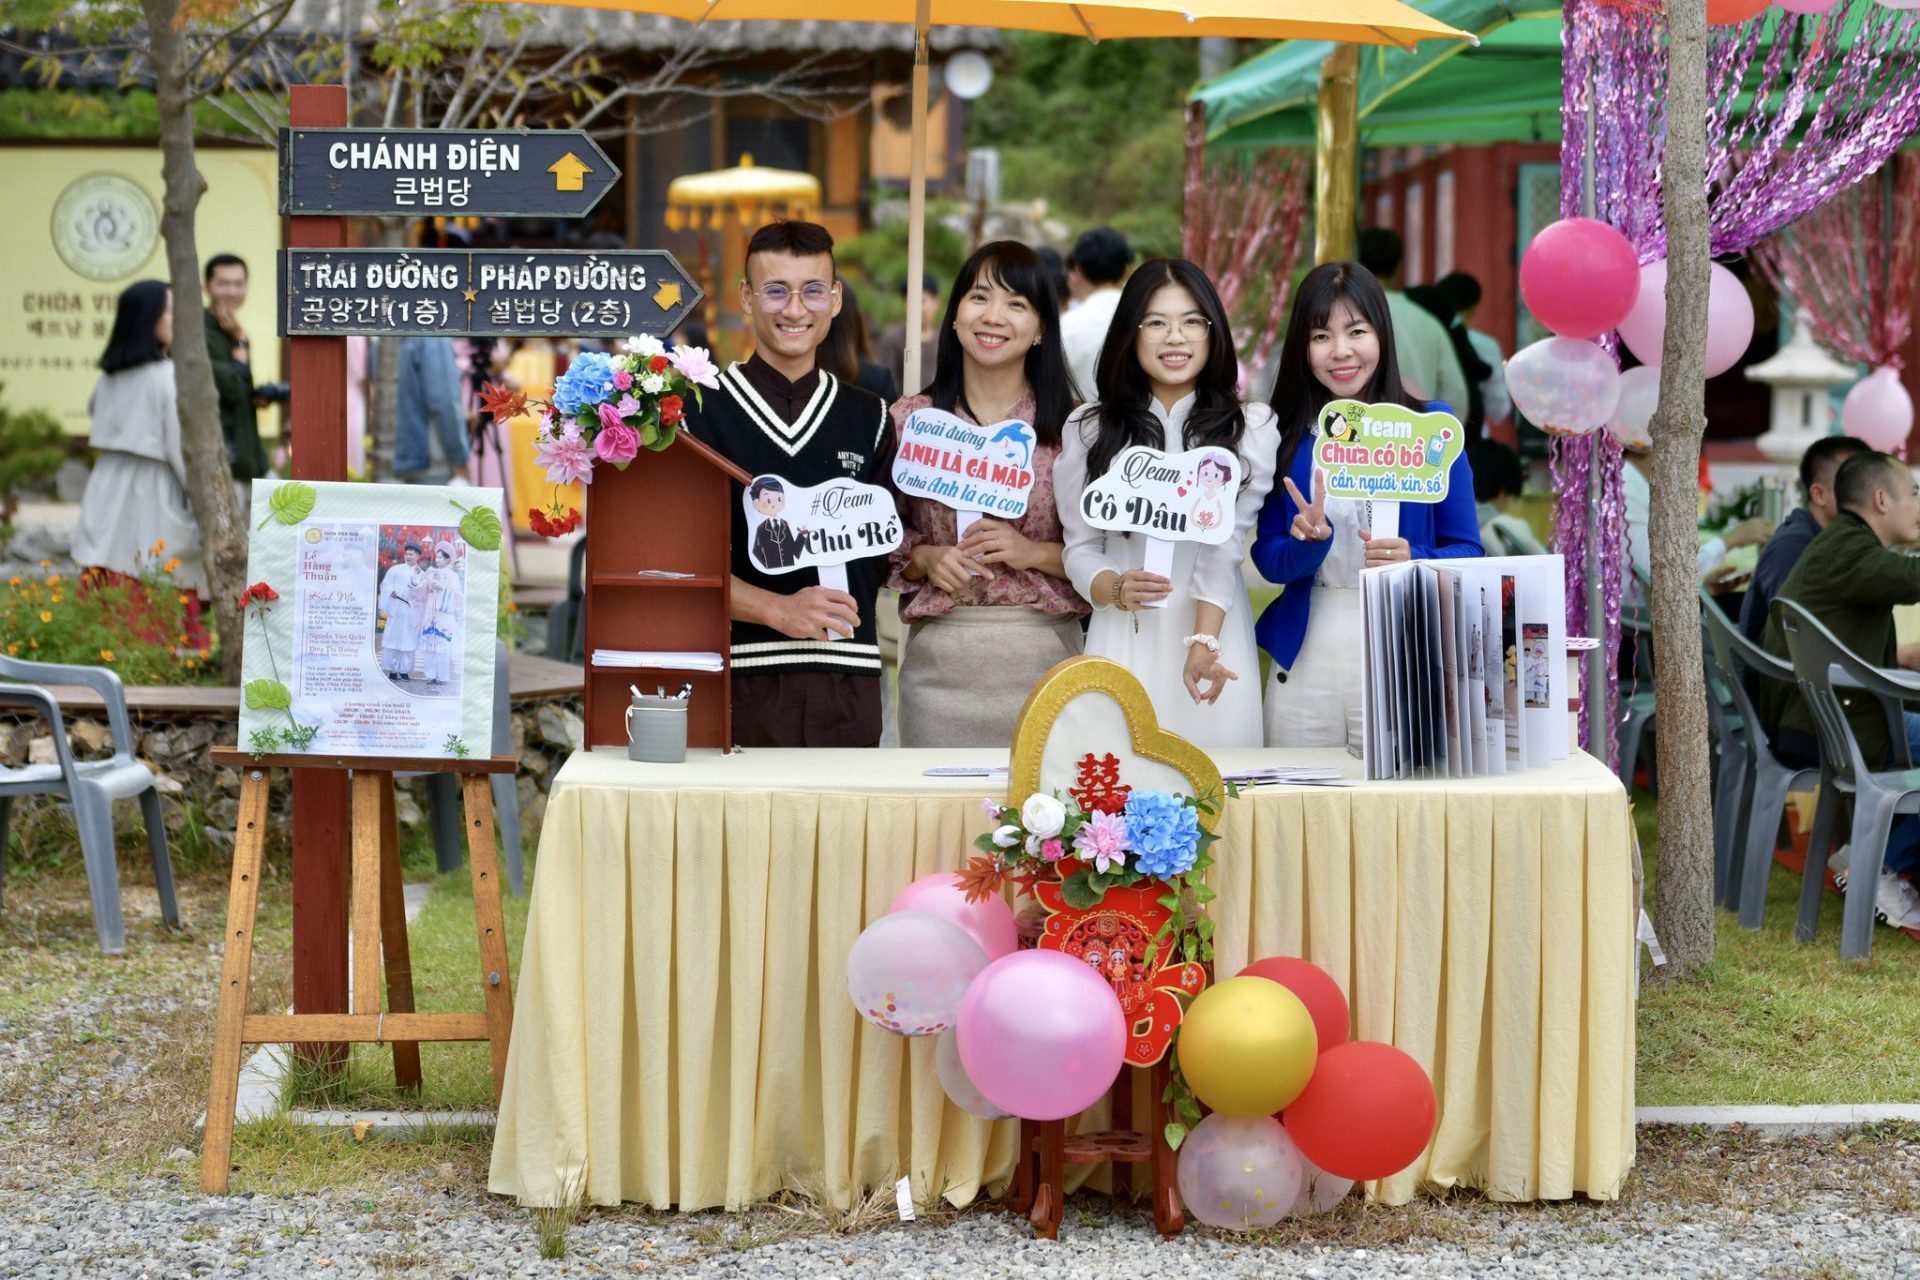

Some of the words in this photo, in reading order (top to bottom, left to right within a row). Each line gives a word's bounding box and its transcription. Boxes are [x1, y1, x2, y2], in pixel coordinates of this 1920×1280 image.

[329, 136, 437, 170] CHÁNH
[393, 177, 472, 206] 큰법당
[480, 256, 550, 290] PHÁP
[301, 297, 379, 323] 공양간
[387, 298, 449, 327] (1층)
[488, 298, 563, 325] 설법당
[571, 299, 631, 327] (2층)
[907, 415, 946, 436] Ngoài
[946, 425, 987, 450] đường
[1360, 417, 1412, 438] Team
[899, 442, 940, 468] ANH
[941, 449, 962, 474] LÀ
[966, 456, 988, 481] CÁ
[991, 463, 1031, 491] MẬP
[1321, 442, 1369, 465] Chưa
[1374, 443, 1395, 466] có
[1400, 438, 1425, 467] bồ
[1121, 451, 1181, 489] Team
[1331, 468, 1355, 489] cần
[1359, 473, 1397, 496] người
[1401, 474, 1423, 493] xin
[1427, 473, 1443, 493] số
[897, 467, 908, 484] Ở
[906, 475, 927, 490] nhà
[927, 477, 959, 498] Anh
[960, 484, 977, 502] là
[979, 490, 997, 508] cá
[997, 498, 1024, 514] con
[1083, 490, 1117, 521] Cô
[1125, 496, 1187, 532] Dâu
[805, 525, 853, 555] Chú
[857, 515, 898, 547] Rể
